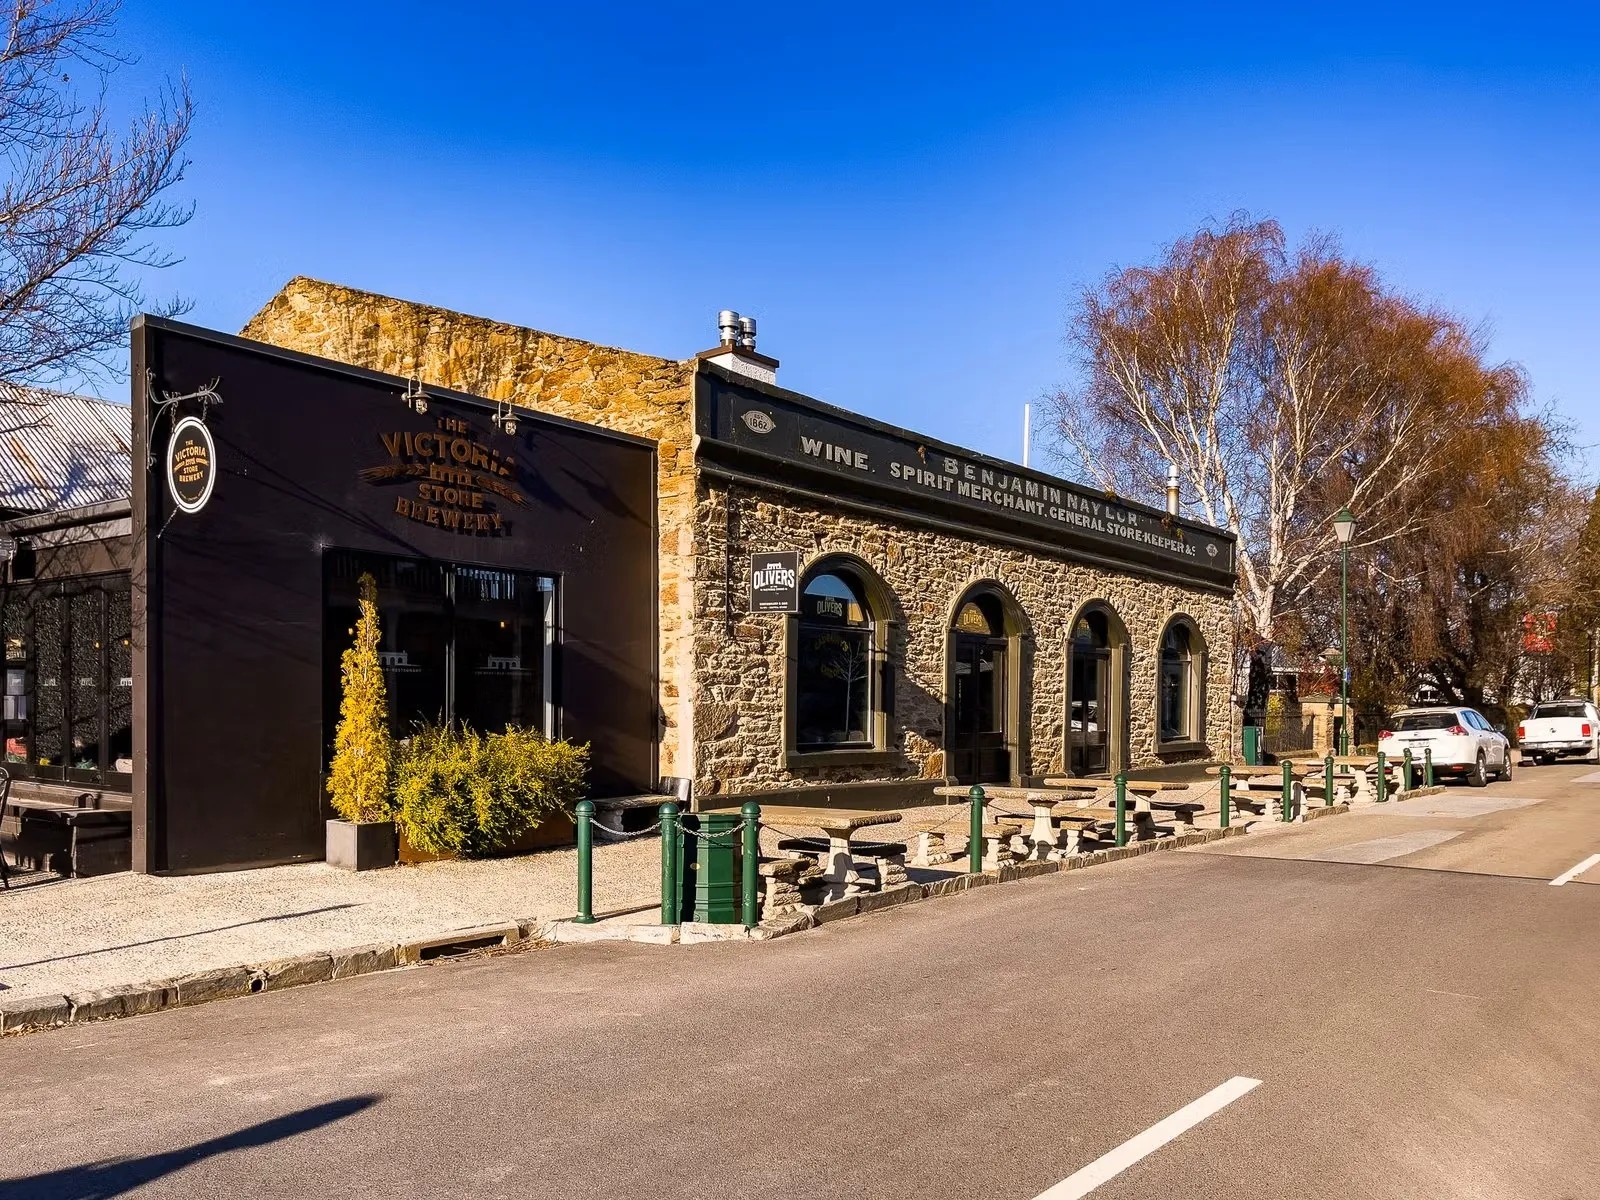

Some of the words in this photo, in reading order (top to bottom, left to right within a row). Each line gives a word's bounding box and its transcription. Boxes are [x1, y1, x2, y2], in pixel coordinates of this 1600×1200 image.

[438, 417, 470, 434] THE
[750, 418, 767, 430] 1862
[175, 446, 206, 462] VICTORIA
[179, 470, 204, 482] BREWERY
[183, 465, 198, 474] STORE
[418, 483, 484, 508] STORE
[890, 461, 954, 491] SPIRIT
[1049, 506, 1105, 533] GENERAL
[944, 457, 1060, 504] BENJAMIN
[1067, 493, 1137, 527] NAYLOR
[395, 495, 501, 530] BREWERY
[753, 568, 795, 590] OLIVERS
[816, 600, 842, 617] OLIVERS
[963, 613, 982, 627] OLIVERS
